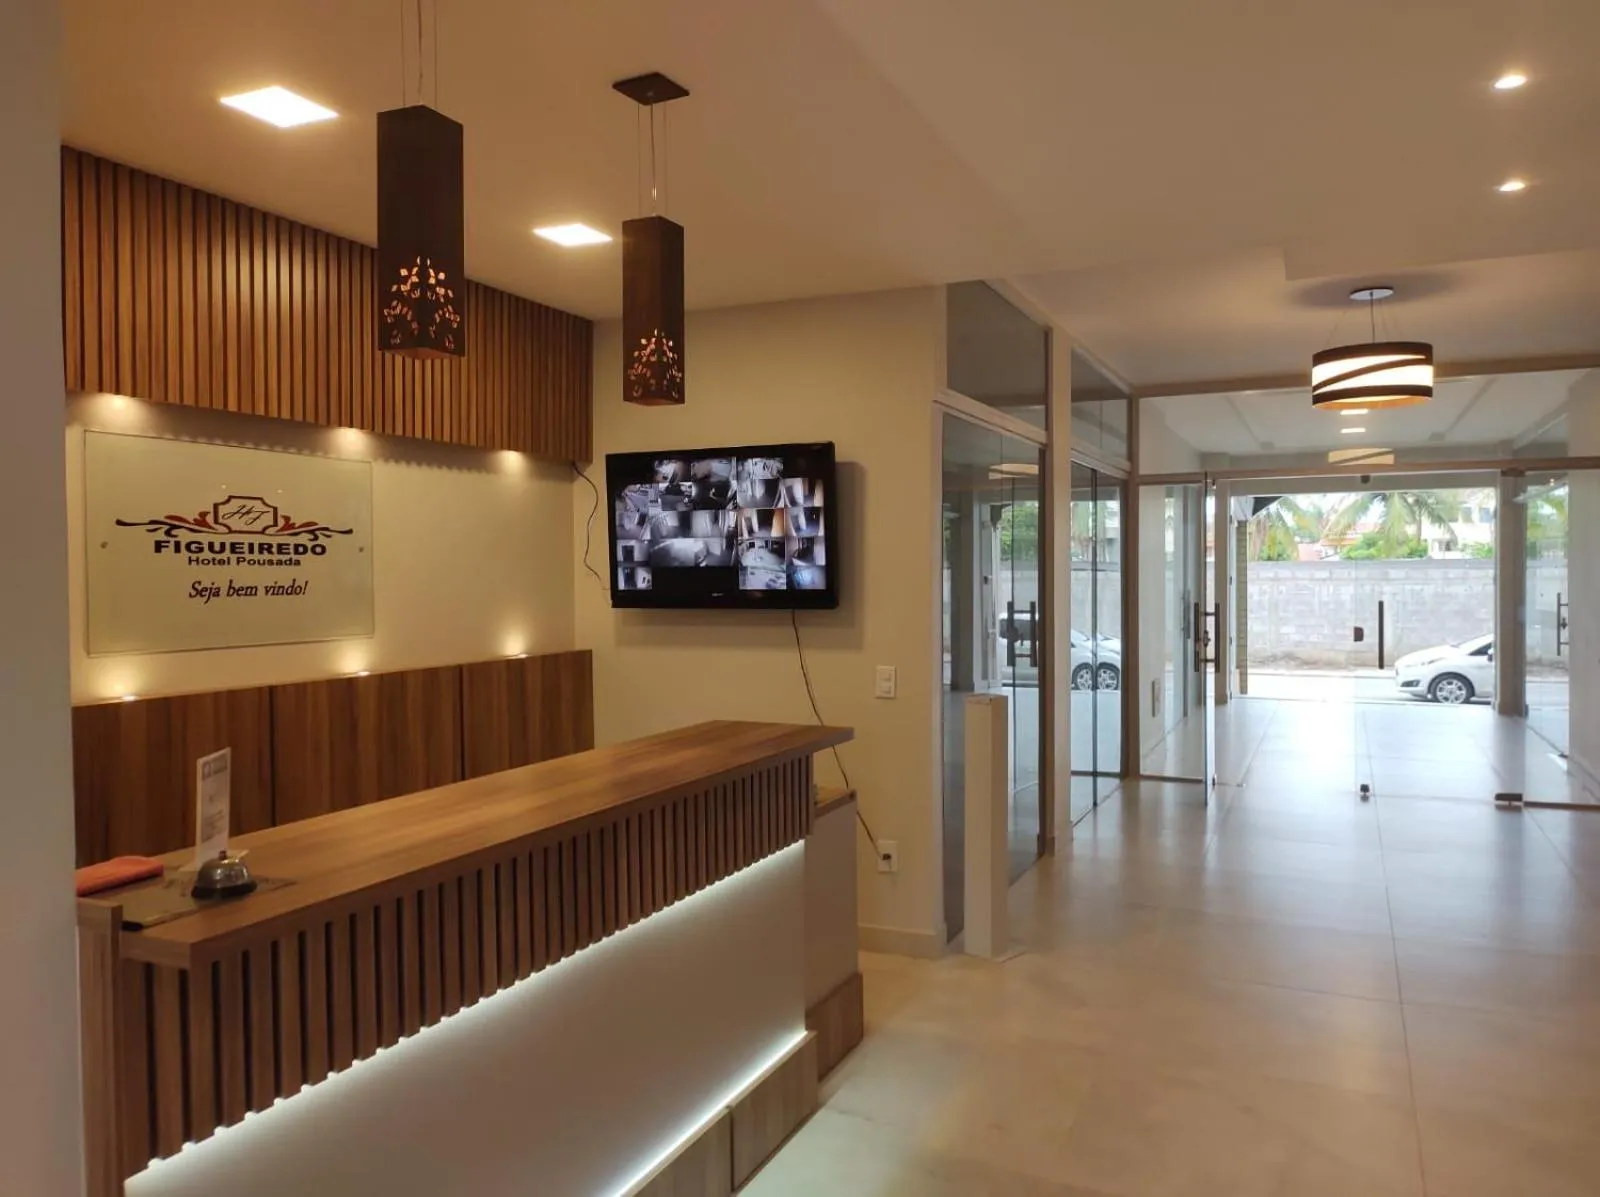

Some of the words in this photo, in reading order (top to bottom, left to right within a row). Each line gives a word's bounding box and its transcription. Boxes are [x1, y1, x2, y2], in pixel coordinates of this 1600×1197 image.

[154, 540, 327, 556] FIGUEIREDO
[188, 556, 231, 566] Hotel
[236, 556, 302, 567] Pousada
[188, 580, 221, 604] Seja
[226, 579, 258, 597] bem
[264, 578, 309, 597] vindo!
